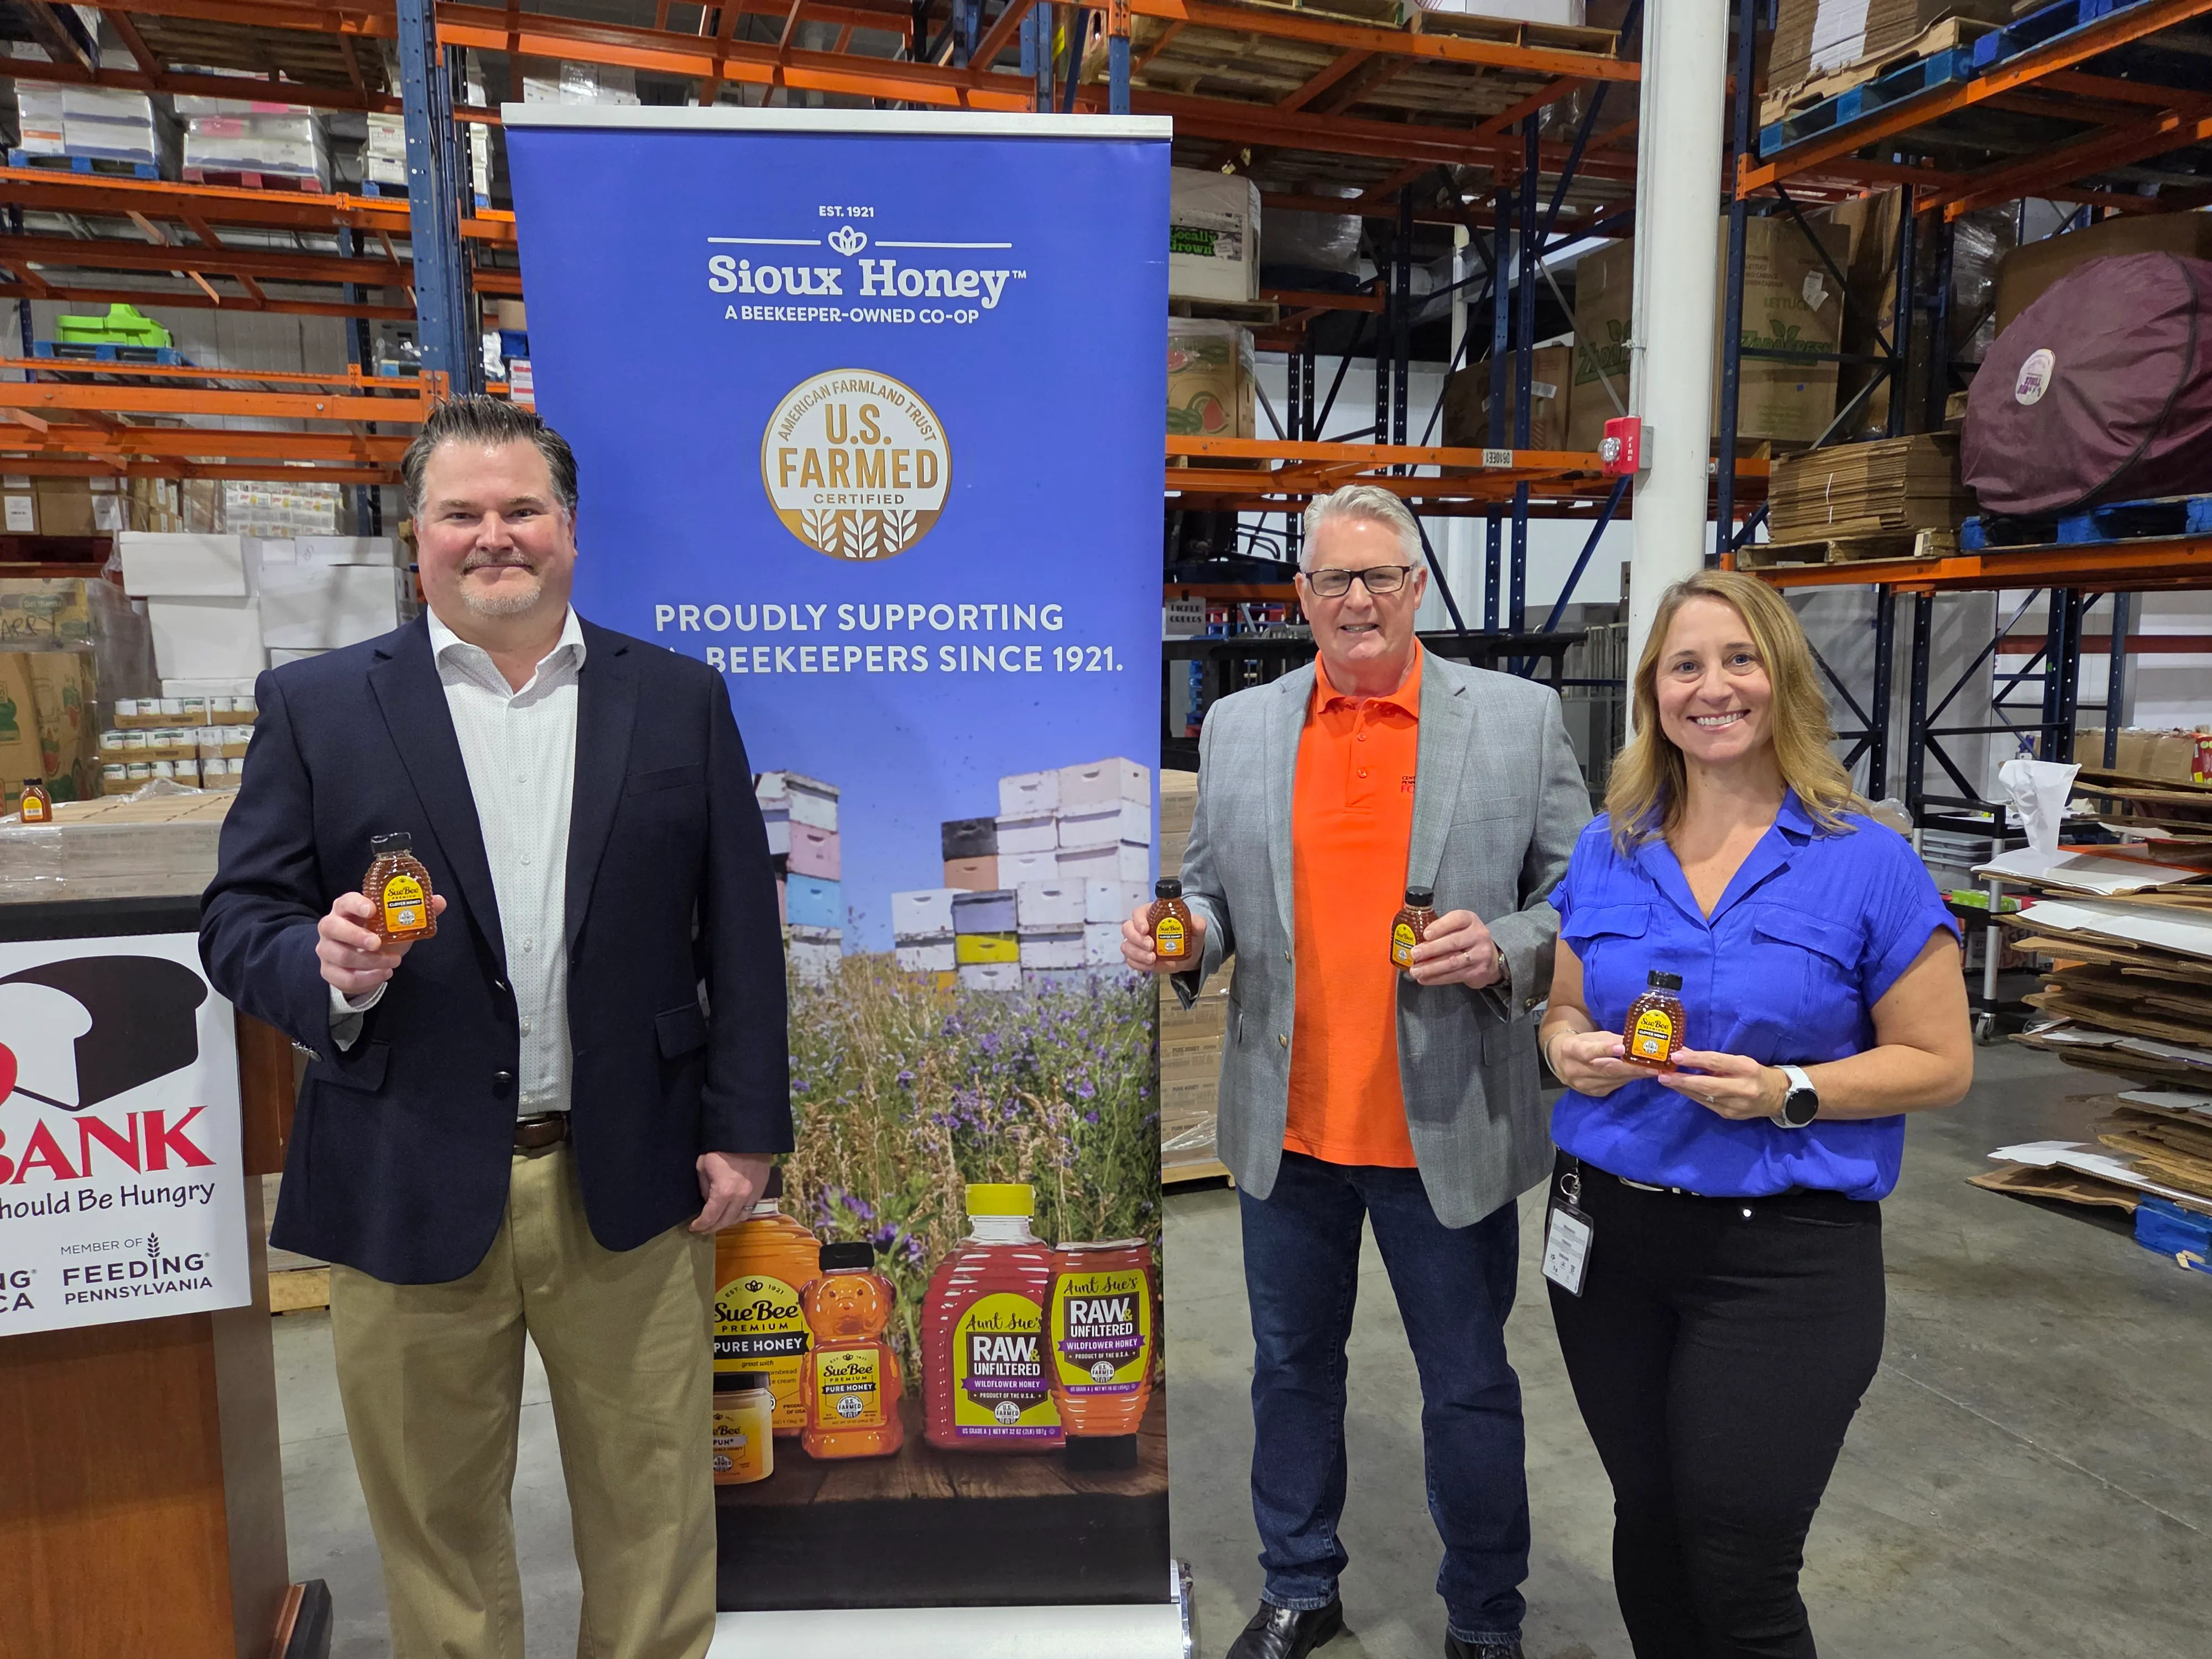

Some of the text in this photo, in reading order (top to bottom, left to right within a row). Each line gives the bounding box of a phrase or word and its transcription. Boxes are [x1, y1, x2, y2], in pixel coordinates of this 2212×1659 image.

[819, 206, 874, 217] EST. 1921
[708, 255, 843, 295] Sioux
[858, 259, 1010, 309] Honey
[725, 306, 979, 323] A BEEKEEPER-OWNED CO-OP
[778, 379, 937, 441] AMERICAN FARMLAND TRUST
[825, 404, 892, 445] U.S.
[779, 447, 938, 489] FARMED
[813, 493, 905, 504] CERTIFIED
[655, 604, 1064, 632] PROUDLY SUPPORTING
[707, 645, 1123, 673] BEEKEEPERS SINCE 1921.
[0, 1182, 215, 1219] hould Be Hungry
[61, 1238, 144, 1255] MEMBER OF
[62, 1253, 205, 1286] FEEDING
[65, 1276, 213, 1305] PENNSYLVANIA
[768, 1284, 784, 1295] 1921
[1064, 1276, 1139, 1295] Aunt Sue's
[1070, 1297, 1133, 1324] RAW &
[722, 1322, 789, 1333] PREMIUM
[966, 1312, 1042, 1331] Aunt Sue's
[1071, 1322, 1133, 1338] UNFILTERED
[714, 1338, 802, 1353] PURE HONEY
[973, 1336, 1040, 1362] RAW &
[1066, 1338, 1138, 1351] WILDFLOWER HONEY
[974, 1363, 1041, 1376] UNFILTERED
